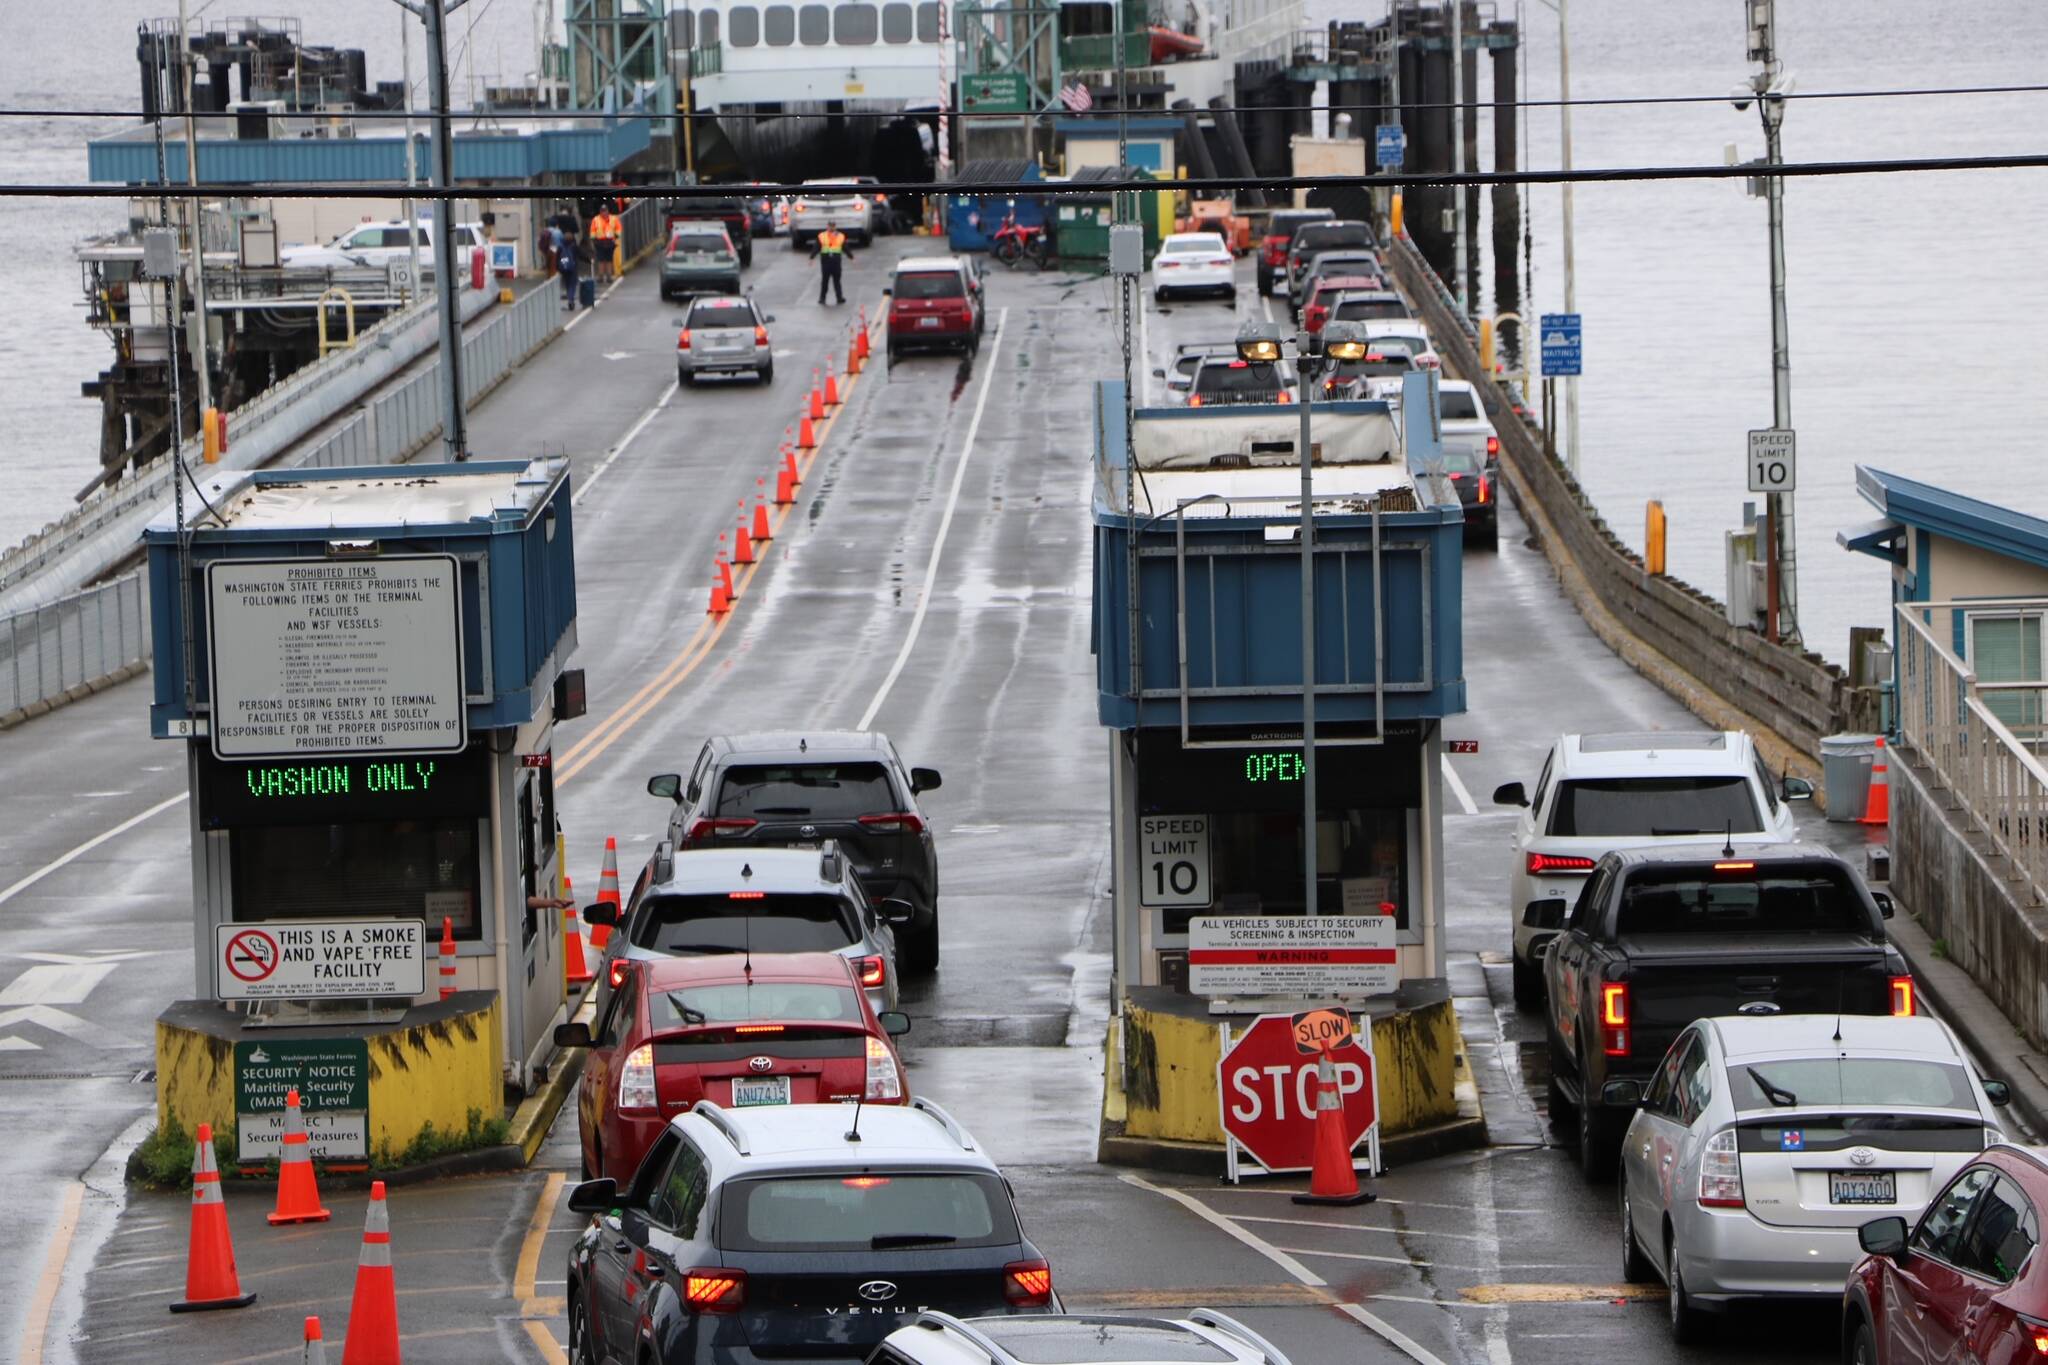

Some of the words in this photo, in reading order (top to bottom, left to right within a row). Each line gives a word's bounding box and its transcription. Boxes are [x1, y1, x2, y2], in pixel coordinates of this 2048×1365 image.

[394, 272, 407, 282] 10
[1752, 436, 1792, 445] SPEED
[1756, 448, 1787, 458] LIMIT
[1757, 462, 1787, 485] 10
[288, 568, 343, 579] PROHIBITED
[349, 567, 377, 577] ITEMS
[224, 582, 285, 594] WASHINGTON
[290, 582, 318, 592] STATE
[324, 580, 363, 591] FERRIES
[368, 579, 418, 590] PROHIBITS
[424, 578, 441, 589] THE
[243, 596, 297, 606] FOLLOWING
[302, 594, 330, 605] ITEMS
[335, 594, 349, 604] ON
[354, 593, 371, 603] THE
[377, 592, 423, 602] TERMINAL
[308, 606, 359, 617] FACILITIES
[287, 621, 306, 632] AND
[312, 620, 332, 631] WSF
[337, 618, 383, 630] VESSELS:
[239, 700, 283, 710] PERSONS
[288, 698, 332, 709] DESIRING
[337, 698, 367, 708] ENTRY
[374, 696, 385, 707] TO
[391, 695, 437, 706] TERMINAL
[248, 712, 298, 724] FACILITIES
[303, 711, 317, 722] OR
[322, 710, 364, 721] VESSELS
[370, 710, 388, 720] ARE
[394, 708, 429, 719] SOLELY
[220, 726, 286, 737] RESPONSIBLE
[291, 725, 310, 735] FOR
[316, 724, 332, 734] THE
[338, 723, 376, 734] PROPER
[381, 721, 440, 733] DISPOSITION
[445, 720, 457, 730] OF
[296, 737, 351, 748] PROHIBITED
[356, 736, 386, 746] ITEMS.
[1251, 732, 1304, 740] DAKTRONIC
[248, 765, 350, 797] VASHON
[367, 762, 435, 792] ONLY
[1144, 820, 1205, 834] SPEED
[1152, 840, 1199, 855] LIMIT
[1153, 860, 1198, 895] 10
[1202, 920, 1220, 929] ALL
[1224, 919, 1270, 929] VEHICLES
[1276, 920, 1319, 929] SUBJECT
[1322, 919, 1333, 928] TO
[1337, 919, 1383, 928] SECURITY
[278, 931, 313, 944] THIS
[322, 930, 336, 944] IS
[344, 930, 354, 943] A
[362, 928, 416, 943] SMOKE
[1230, 930, 1285, 939] SCREENING
[1288, 930, 1295, 939] &
[1299, 930, 1355, 939] INSPECTION
[282, 948, 315, 962] AND
[324, 947, 364, 961] VAPE
[373, 946, 412, 960] FREE
[1257, 952, 1329, 962] WARNING
[314, 964, 382, 978] FACILITY
[1300, 1018, 1344, 1042] SLOW
[243, 1067, 301, 1080] SECURITY
[310, 1066, 356, 1077] NOTICE
[307, 1081, 355, 1094] Security
[737, 1088, 786, 1100] ANU7415
[250, 1095, 312, 1110] (MARSC)
[320, 1095, 350, 1106] Level
[1834, 1182, 1892, 1199] ADY3400
[825, 1306, 929, 1316] VENUE
